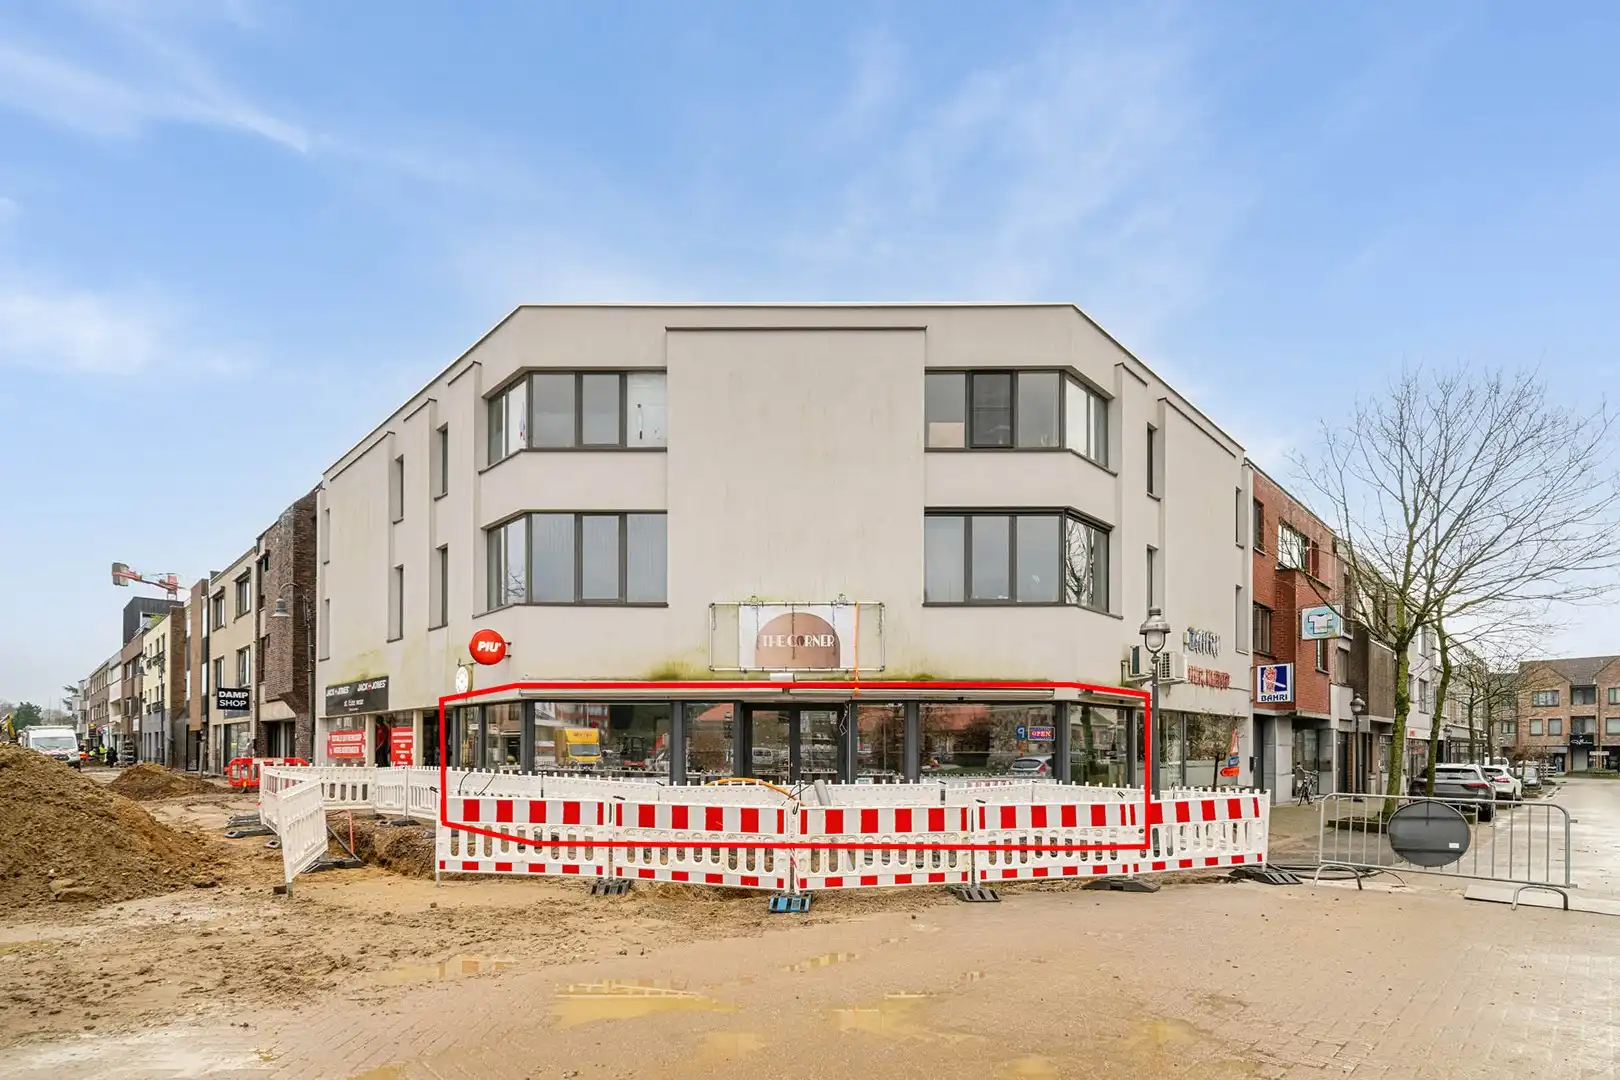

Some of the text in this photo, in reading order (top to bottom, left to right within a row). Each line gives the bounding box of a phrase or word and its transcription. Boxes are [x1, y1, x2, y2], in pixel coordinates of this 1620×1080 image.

[763, 634, 786, 647] THE
[218, 691, 249, 699] DAMP
[1260, 694, 1288, 702] BAHRI
